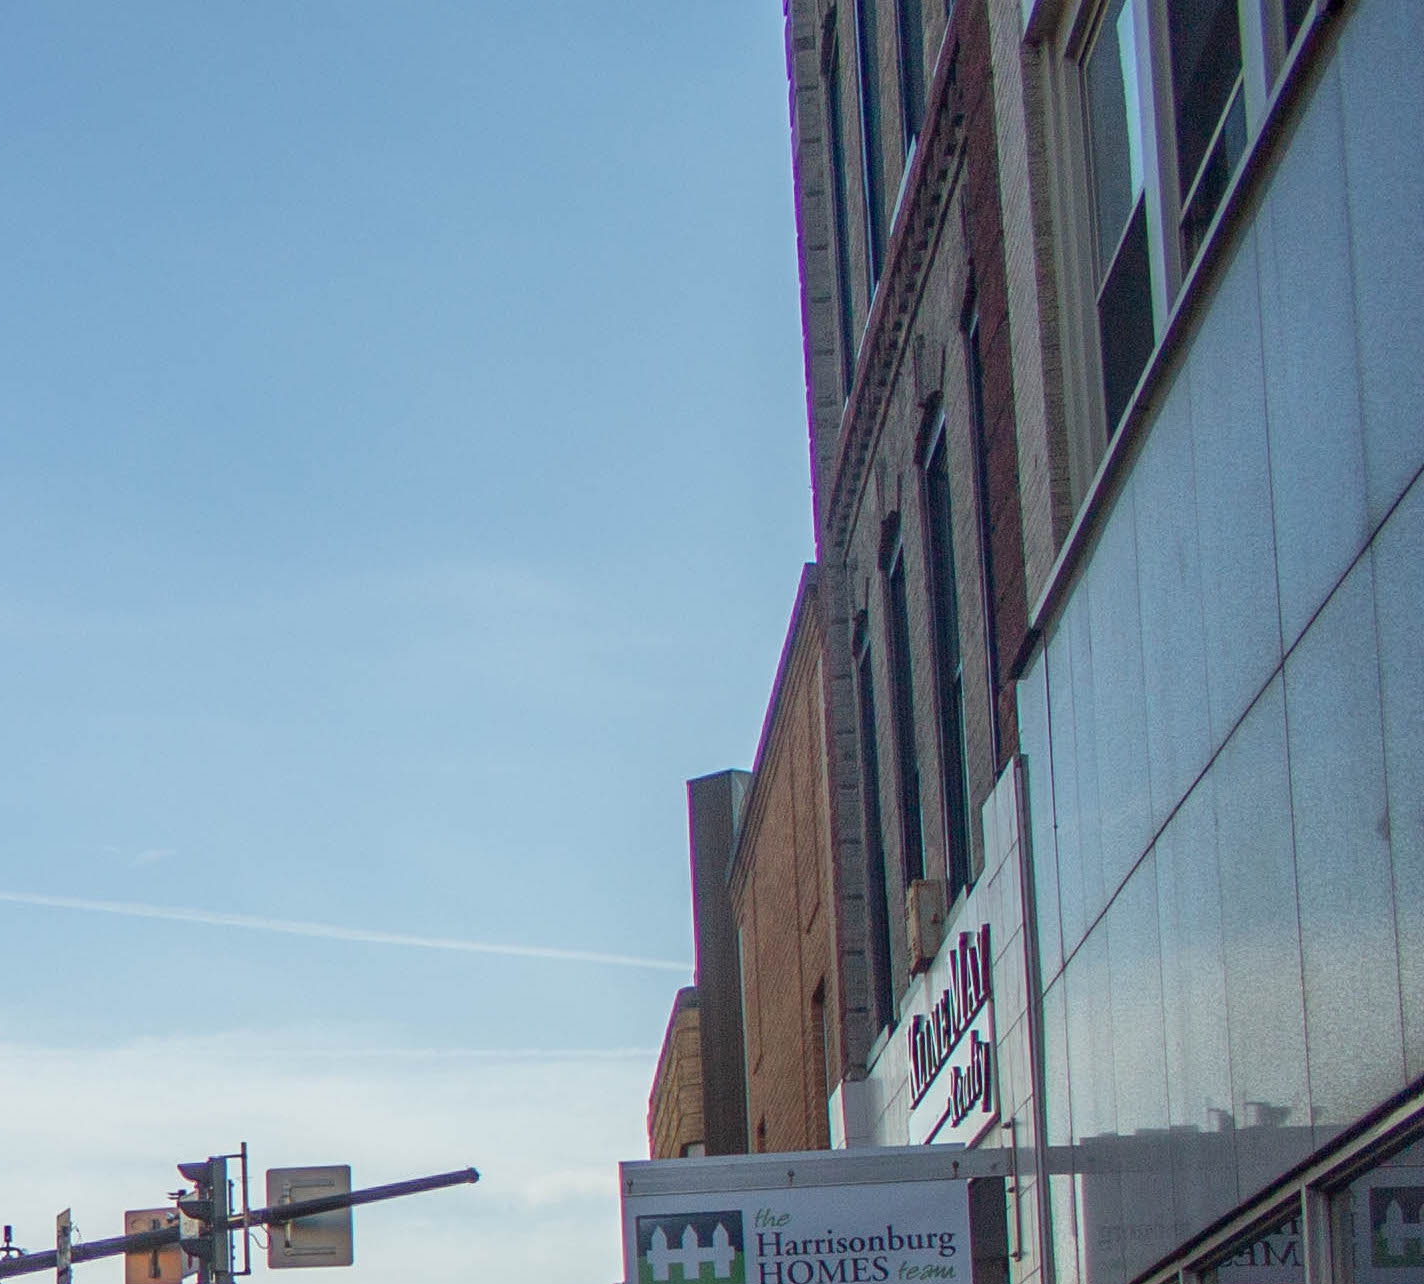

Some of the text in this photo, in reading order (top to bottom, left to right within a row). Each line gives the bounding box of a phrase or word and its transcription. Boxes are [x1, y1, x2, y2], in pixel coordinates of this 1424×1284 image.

[753, 1208, 792, 1228] the
[755, 1223, 957, 1258] Harrisonburg
[897, 1260, 957, 1281] team
